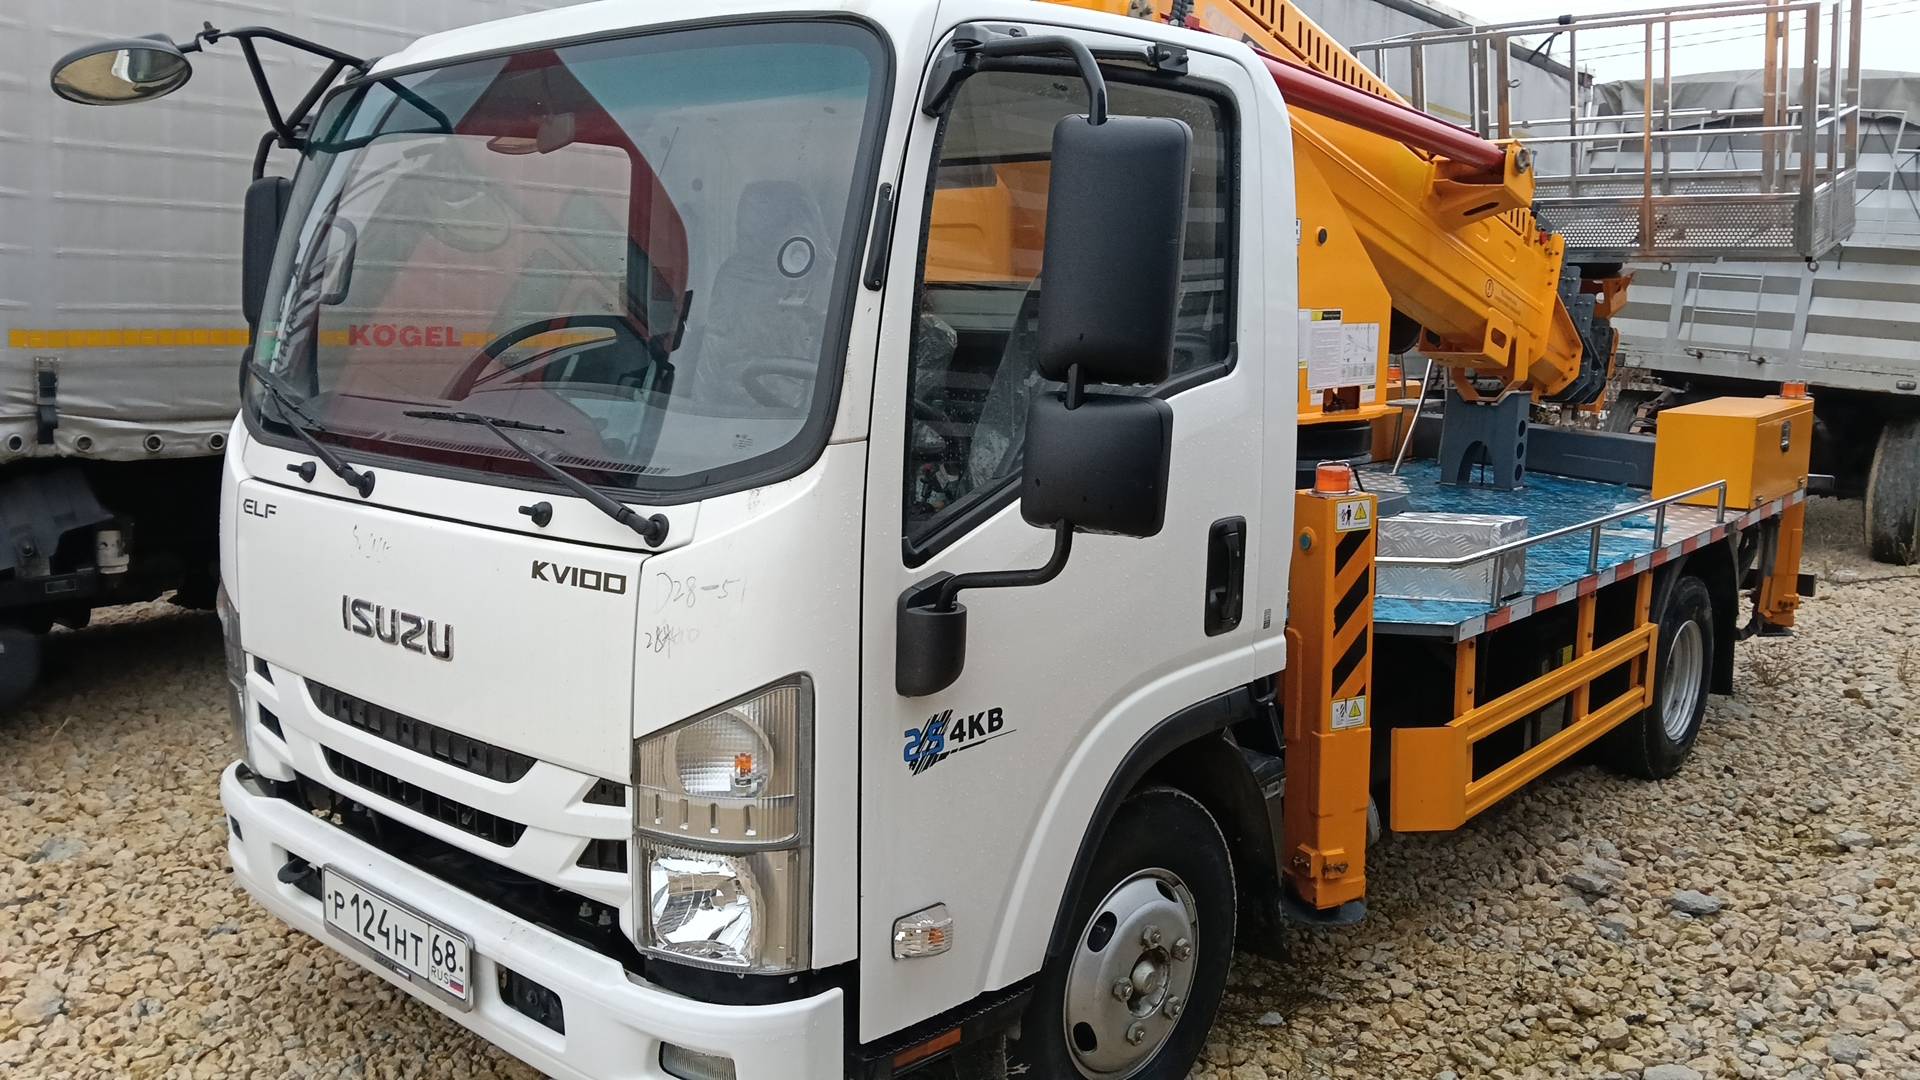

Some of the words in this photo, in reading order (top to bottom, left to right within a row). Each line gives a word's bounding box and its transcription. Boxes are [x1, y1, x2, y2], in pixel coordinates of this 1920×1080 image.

[348, 323, 462, 348] KÖGEL
[243, 499, 277, 519] ELF
[531, 560, 627, 595] KV100
[342, 594, 454, 662] ISUZU
[949, 707, 1004, 743] 4KB
[431, 934, 457, 973] 68
[431, 965, 450, 985] RUS
